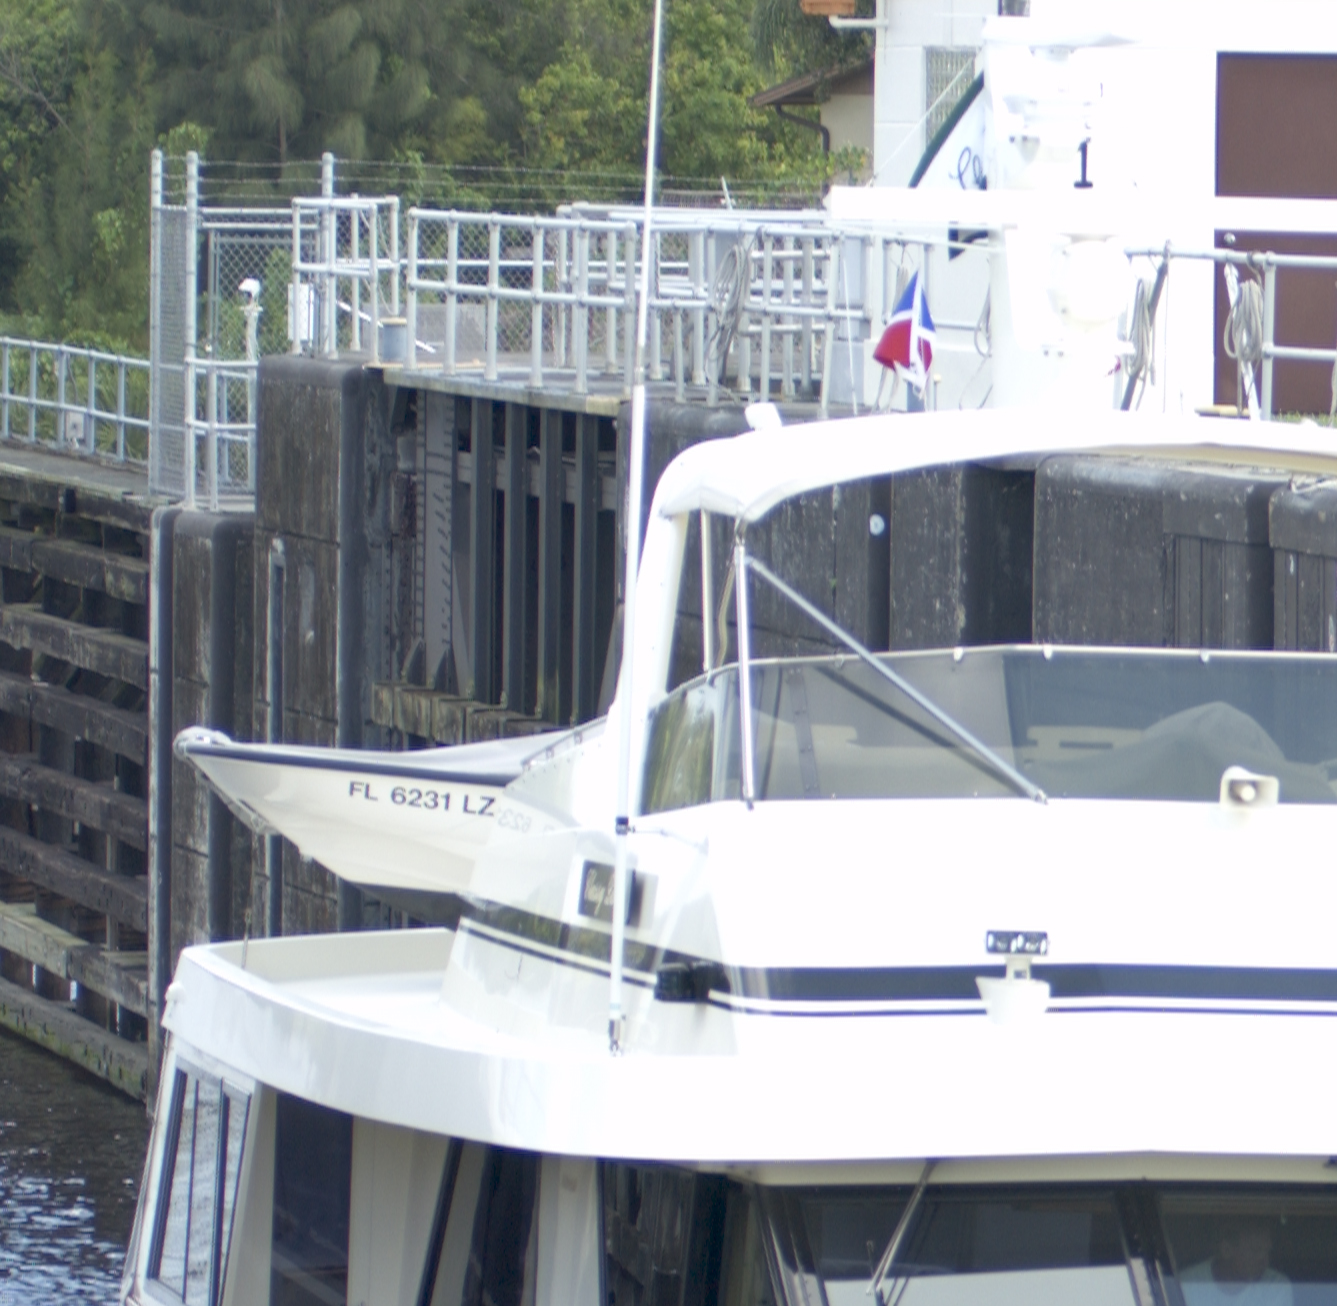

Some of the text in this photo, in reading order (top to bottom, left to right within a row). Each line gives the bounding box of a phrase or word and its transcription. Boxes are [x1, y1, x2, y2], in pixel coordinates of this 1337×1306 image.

[349, 781, 496, 817] FL 6231 LZ
